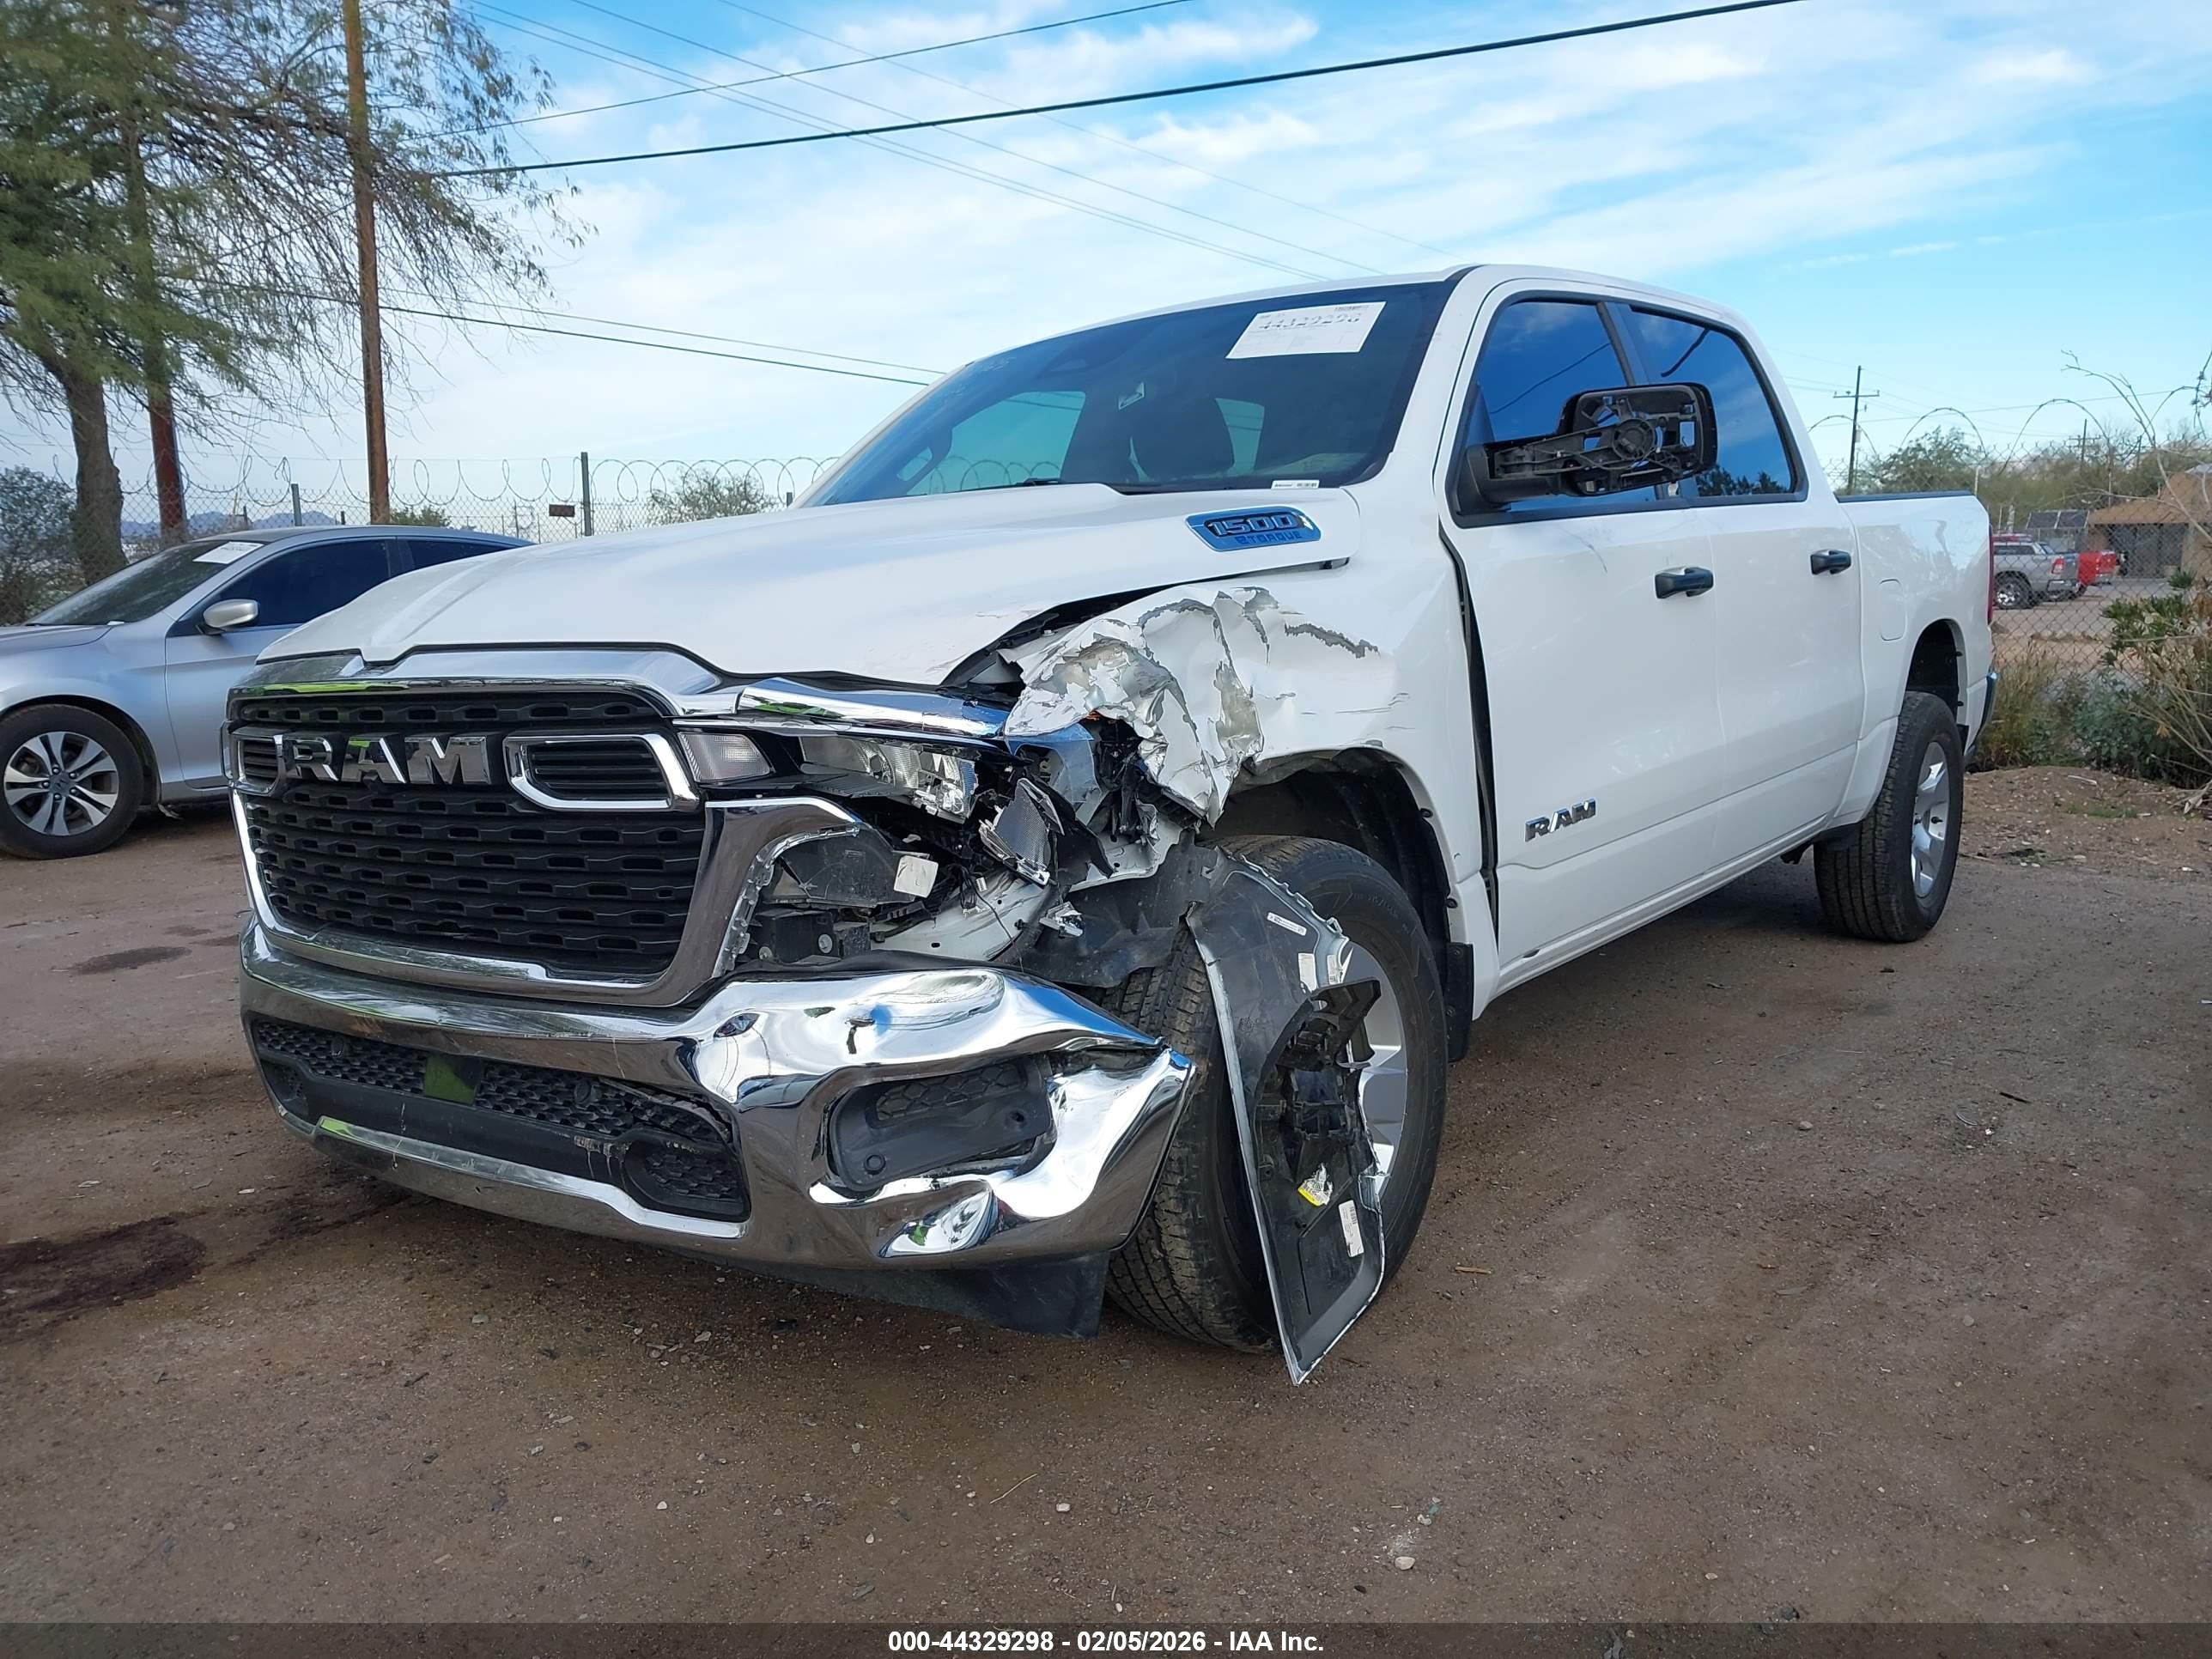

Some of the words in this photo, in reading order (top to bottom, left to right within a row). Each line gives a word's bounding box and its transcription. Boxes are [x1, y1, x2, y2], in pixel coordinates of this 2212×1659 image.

[1207, 514, 1297, 537] 1500
[284, 735, 492, 784] RAM
[1524, 798, 1596, 842] RAM
